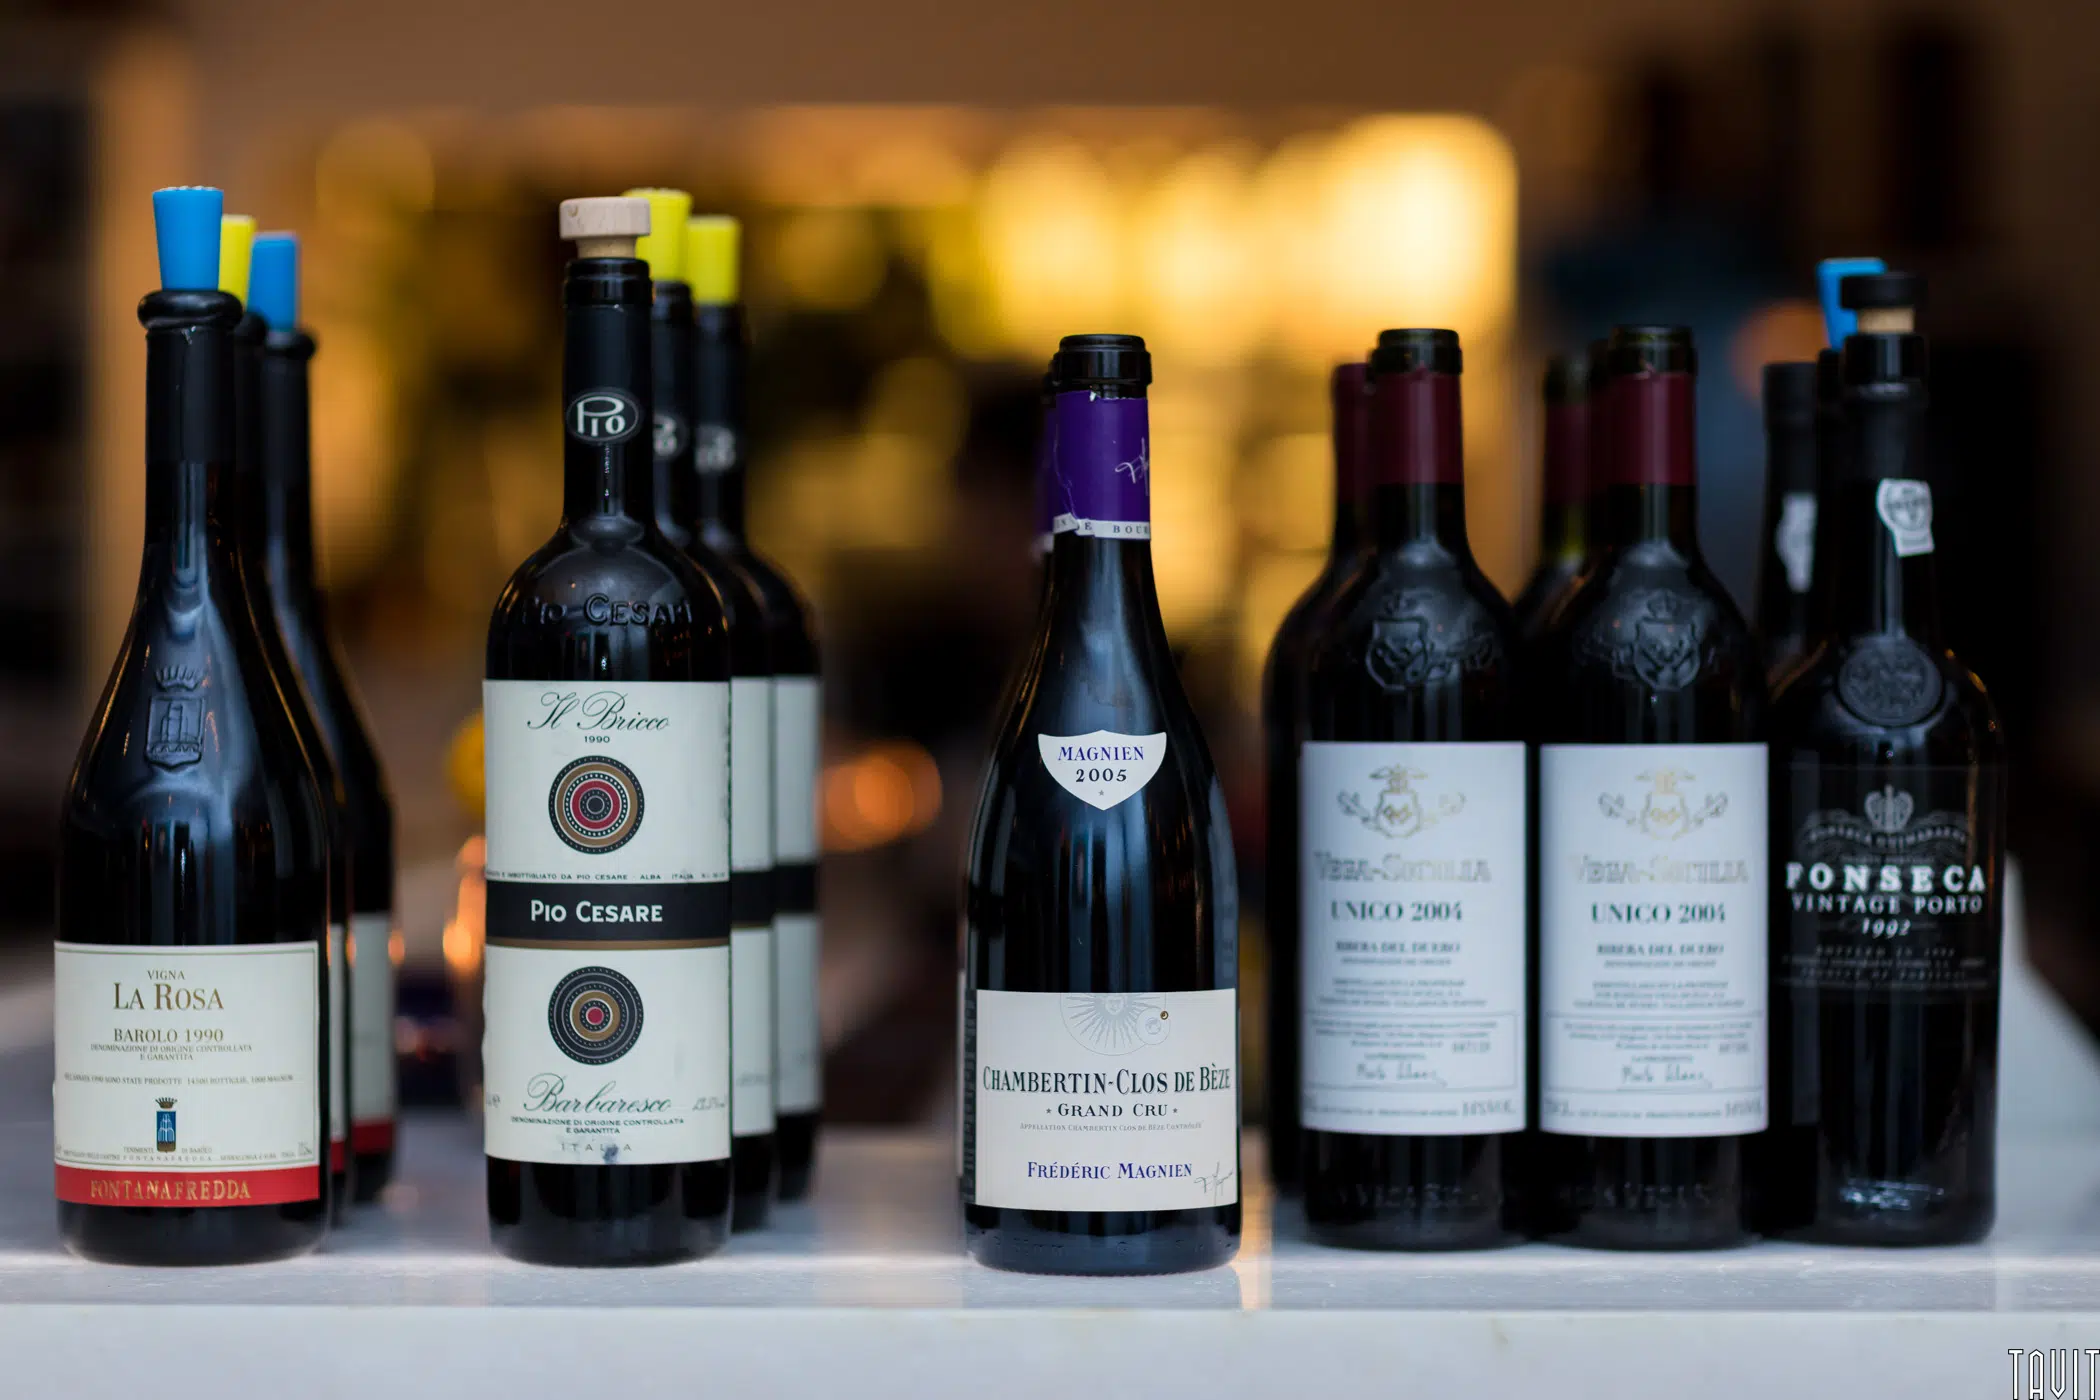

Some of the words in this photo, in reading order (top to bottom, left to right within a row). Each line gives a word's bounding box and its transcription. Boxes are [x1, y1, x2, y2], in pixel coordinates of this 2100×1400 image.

[577, 690, 670, 731] Bricco
[584, 736, 611, 744] 1990
[1058, 746, 1144, 761] MAGNIEN
[1076, 768, 1127, 783] 2005
[1786, 862, 1986, 892] FONSECA
[530, 899, 567, 922] PIO
[576, 900, 663, 923] CESARE
[1410, 901, 1463, 922] 2004
[1678, 902, 1725, 924] 2004
[1792, 892, 1901, 914] VINTAGE
[1914, 894, 1983, 915] PORTO
[147, 970, 185, 980] VIGNA
[113, 982, 145, 1010] LA
[154, 983, 224, 1010] ROSA
[113, 1028, 177, 1042] BAROLO
[185, 1029, 224, 1043] 1990
[983, 1065, 1168, 1095] CHAMBERTIN-CLOS
[1174, 1071, 1195, 1093] DE
[1199, 1062, 1231, 1092] BÈZE
[523, 1072, 671, 1113] Barbaresco
[1057, 1102, 1123, 1118] GRAND
[1132, 1102, 1168, 1117] CRU
[511, 1116, 571, 1126] DENOMINAZIONE
[623, 1118, 684, 1127] CONTROLLATA
[1068, 1124, 1118, 1132] CHAMBERTIN
[1119, 1124, 1137, 1132] CLOS
[1028, 1161, 1111, 1179] FRÉDÉRIC
[1117, 1163, 1193, 1179] MAGNIEN
[90, 1179, 251, 1201] FONTANAFREDDA
